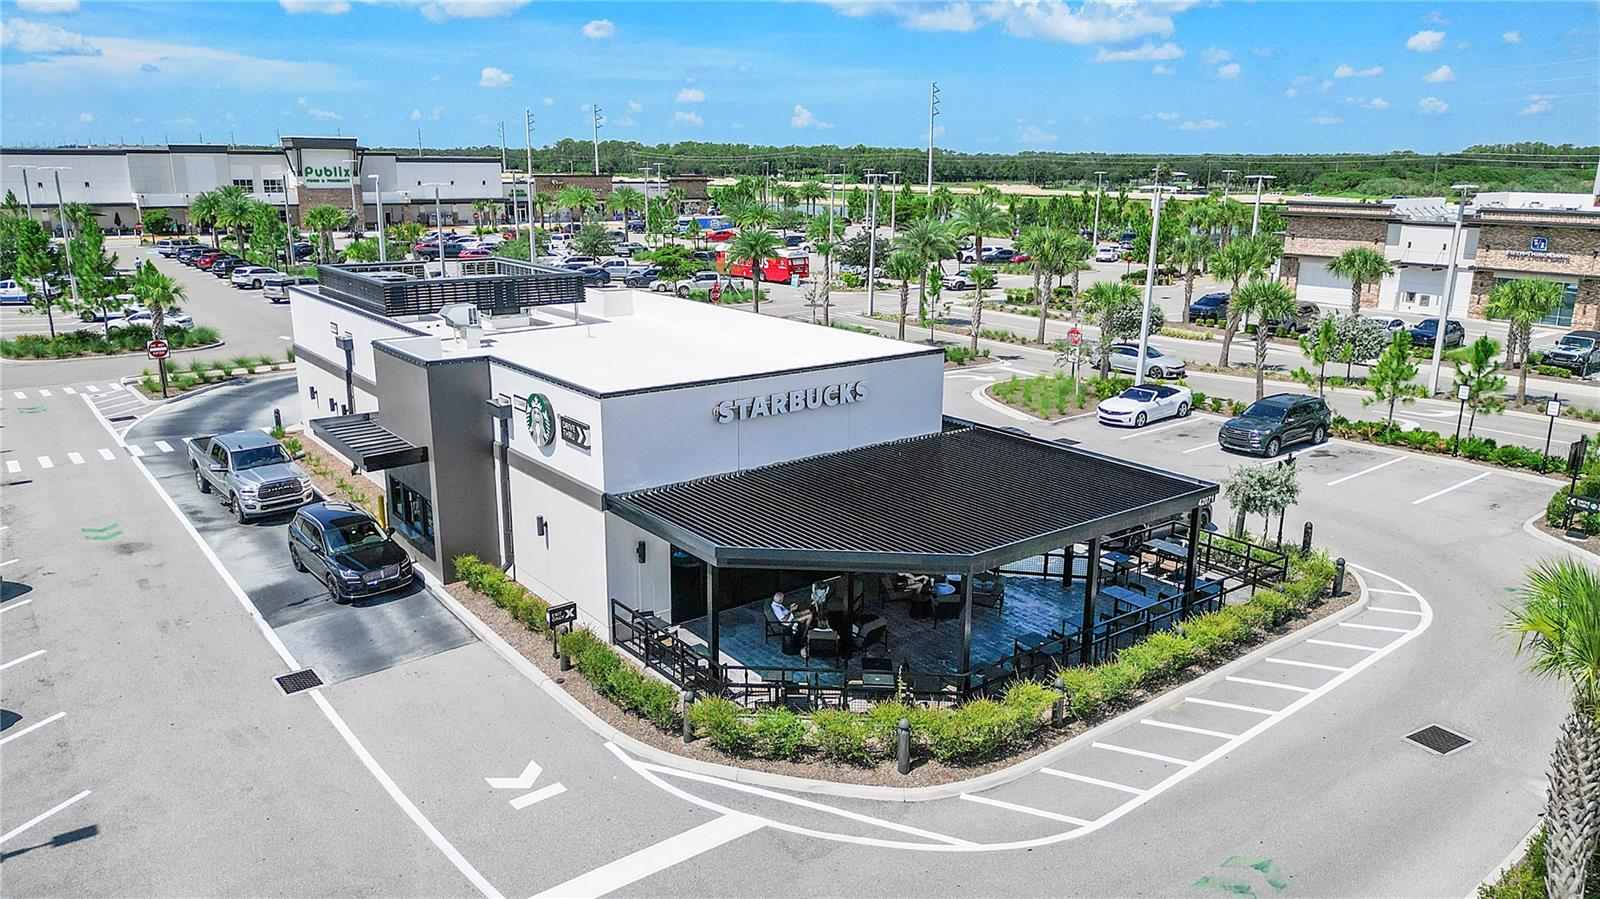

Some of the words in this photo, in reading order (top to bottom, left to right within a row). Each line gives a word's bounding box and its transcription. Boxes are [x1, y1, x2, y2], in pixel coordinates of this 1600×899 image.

[304, 166, 351, 177] Publix
[716, 380, 871, 424] STARBUCKS
[562, 421, 576, 433] DRIVE
[563, 429, 576, 441] THRU
